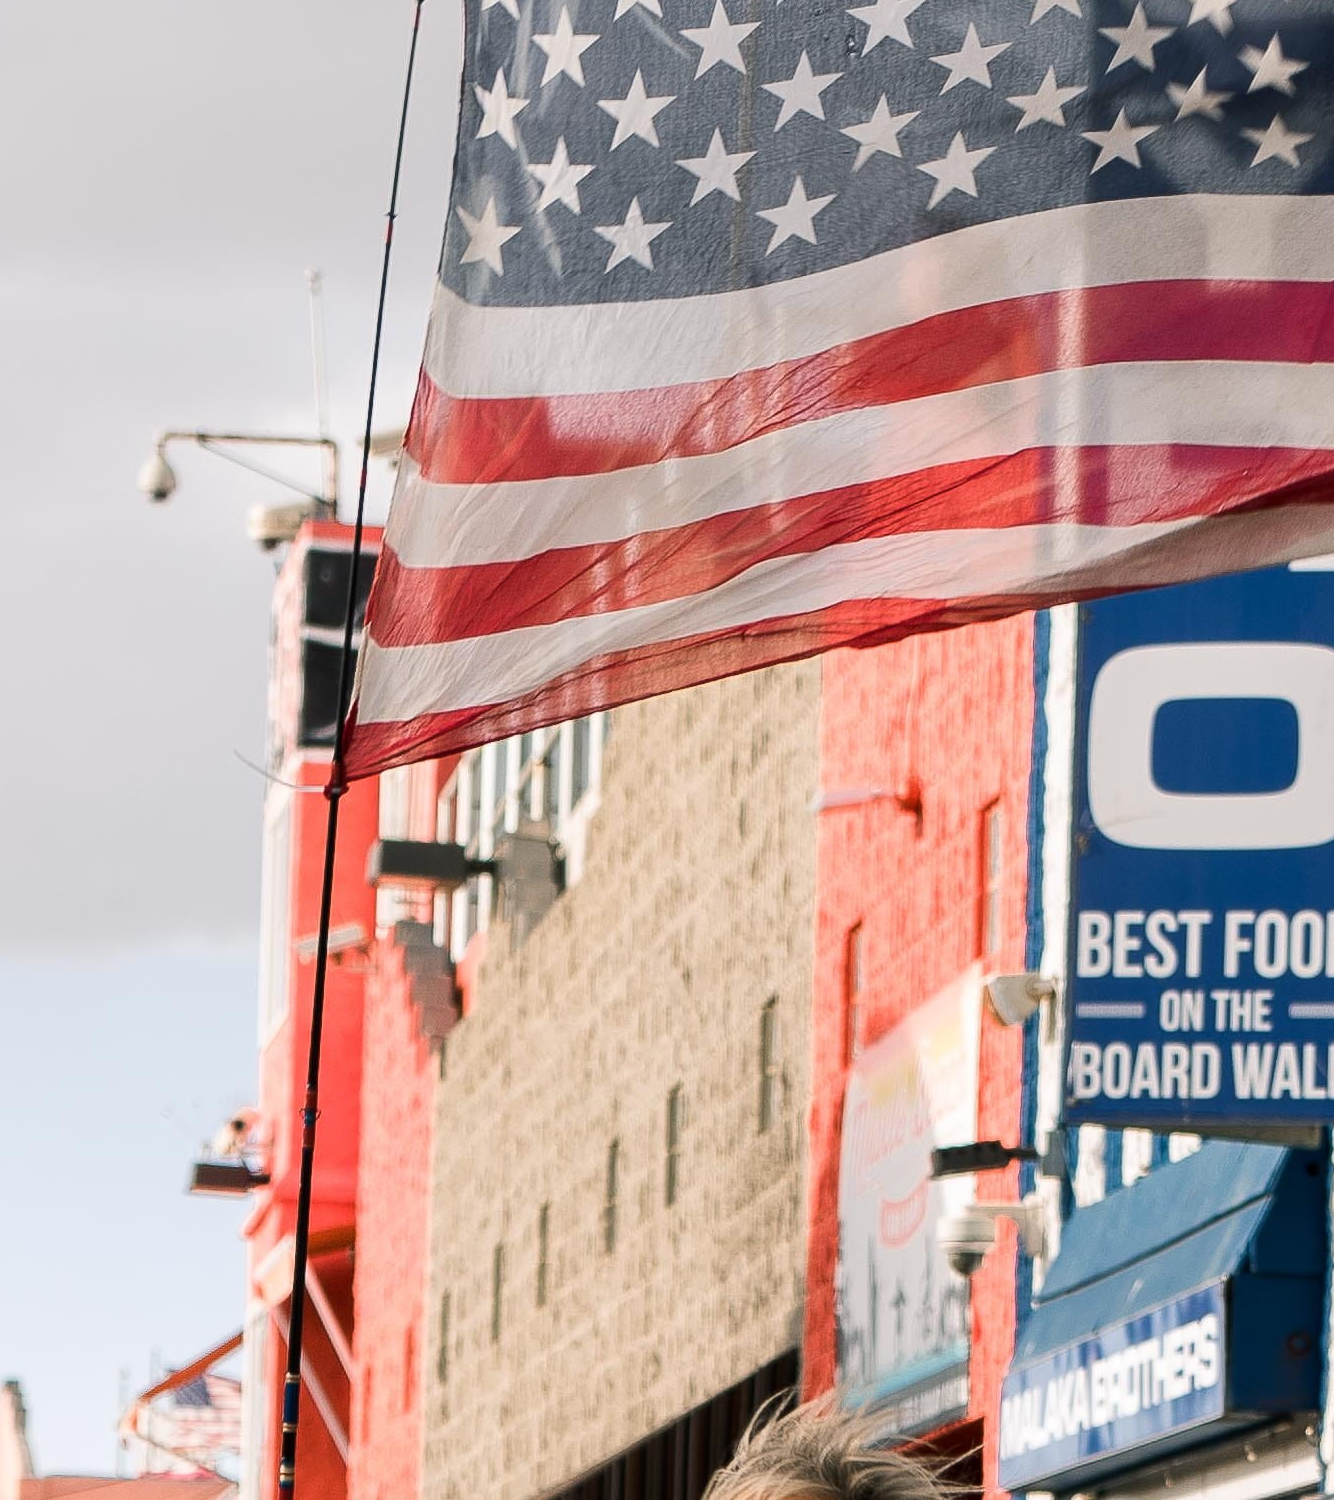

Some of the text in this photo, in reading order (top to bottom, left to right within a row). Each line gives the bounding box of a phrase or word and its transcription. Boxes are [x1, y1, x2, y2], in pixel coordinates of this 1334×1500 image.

[1076, 911, 1210, 978] BEST
[1158, 990, 1273, 1032] ON THE
[1075, 1042, 1220, 1100] BOARD
